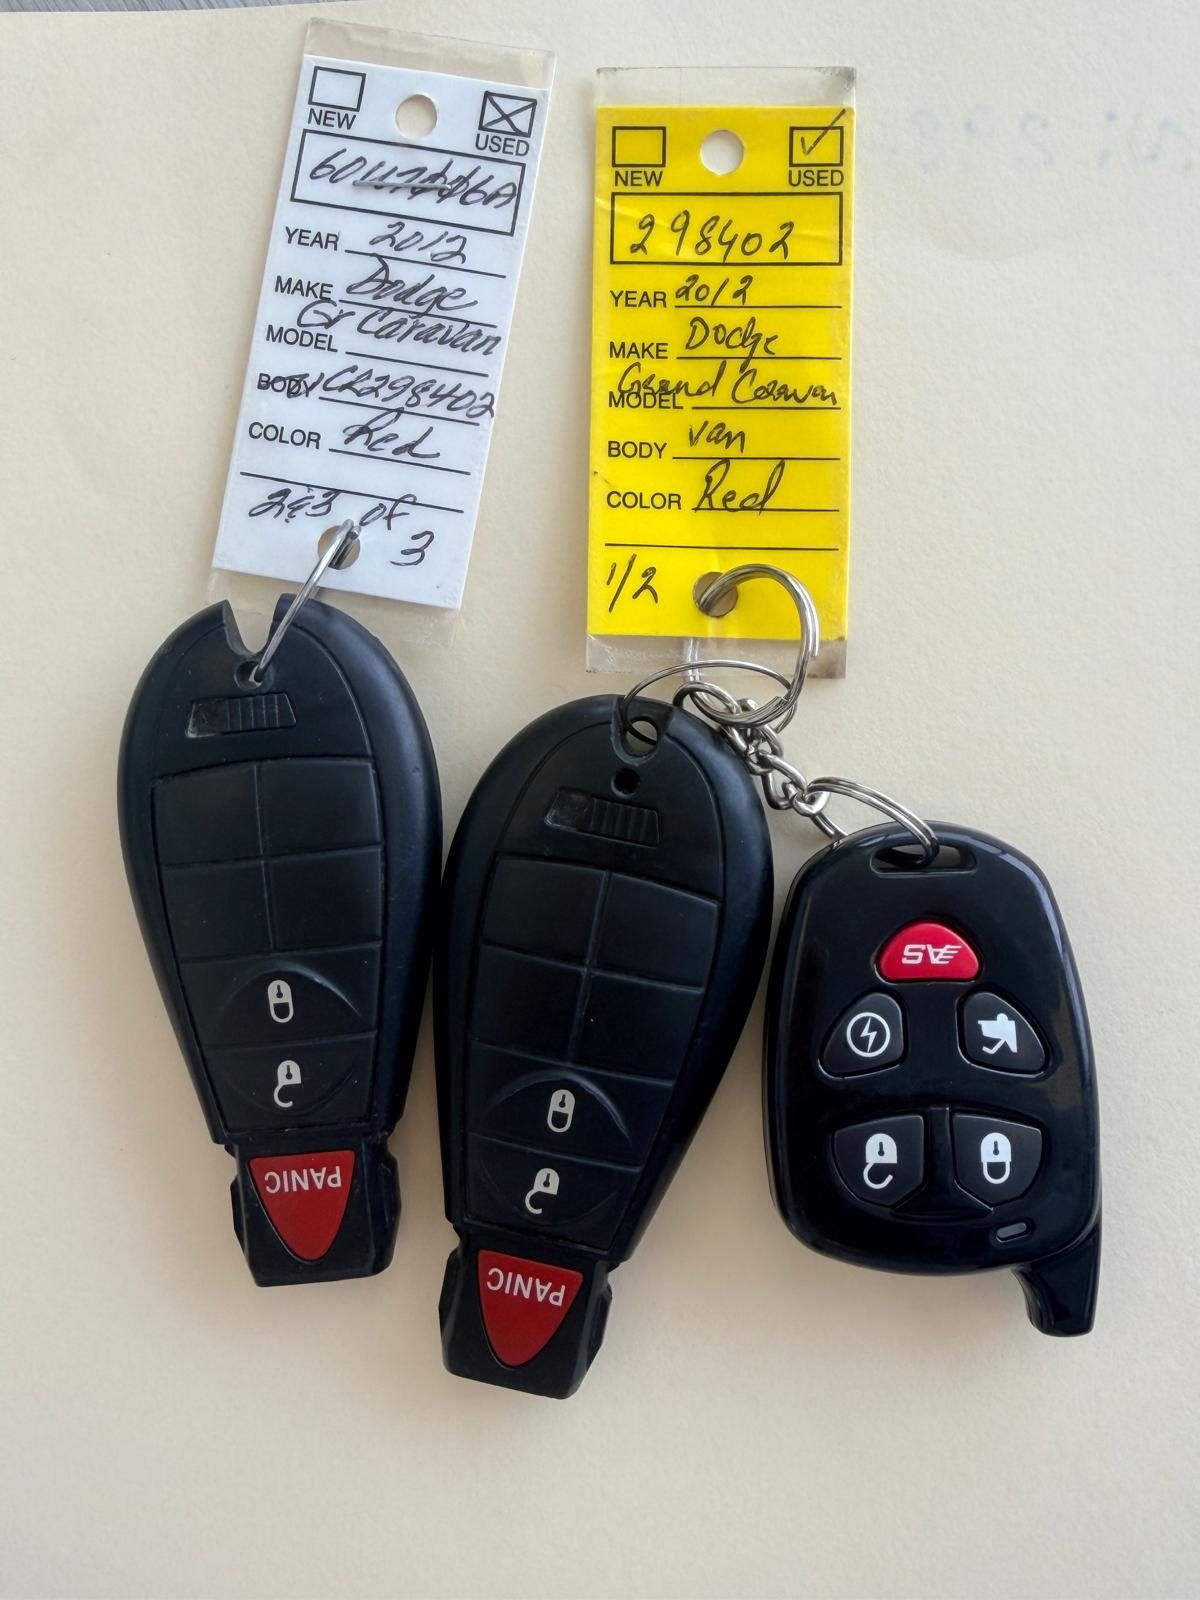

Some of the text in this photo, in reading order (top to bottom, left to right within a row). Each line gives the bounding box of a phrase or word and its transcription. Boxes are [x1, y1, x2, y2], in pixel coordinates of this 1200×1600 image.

[308, 108, 356, 130] NEW
[475, 133, 530, 157] USED
[614, 170, 663, 187] NEW
[788, 170, 844, 187] USED
[285, 227, 340, 250] YEAR
[369, 221, 467, 264] 2012
[630, 210, 795, 263] 298402
[275, 276, 333, 300] MAKE
[346, 253, 478, 319] Dodge
[610, 290, 667, 308] YEAR
[675, 274, 753, 306] 2012
[266, 324, 338, 352] MODEL
[357, 308, 501, 356] Caravan
[685, 316, 778, 373] Dodge
[609, 342, 668, 359] MAKE
[257, 373, 314, 398] BODY
[608, 391, 684, 409] MODEL
[248, 422, 321, 449] COLOR
[343, 407, 440, 459] Red
[607, 440, 667, 459] BODY
[606, 490, 682, 510] COLOR
[693, 458, 785, 515] Red
[360, 494, 417, 530] of
[390, 530, 435, 566] 3
[606, 553, 658, 613] 1/2
[264, 1166, 342, 1194] PANIC
[486, 1267, 566, 1307] PANIC
